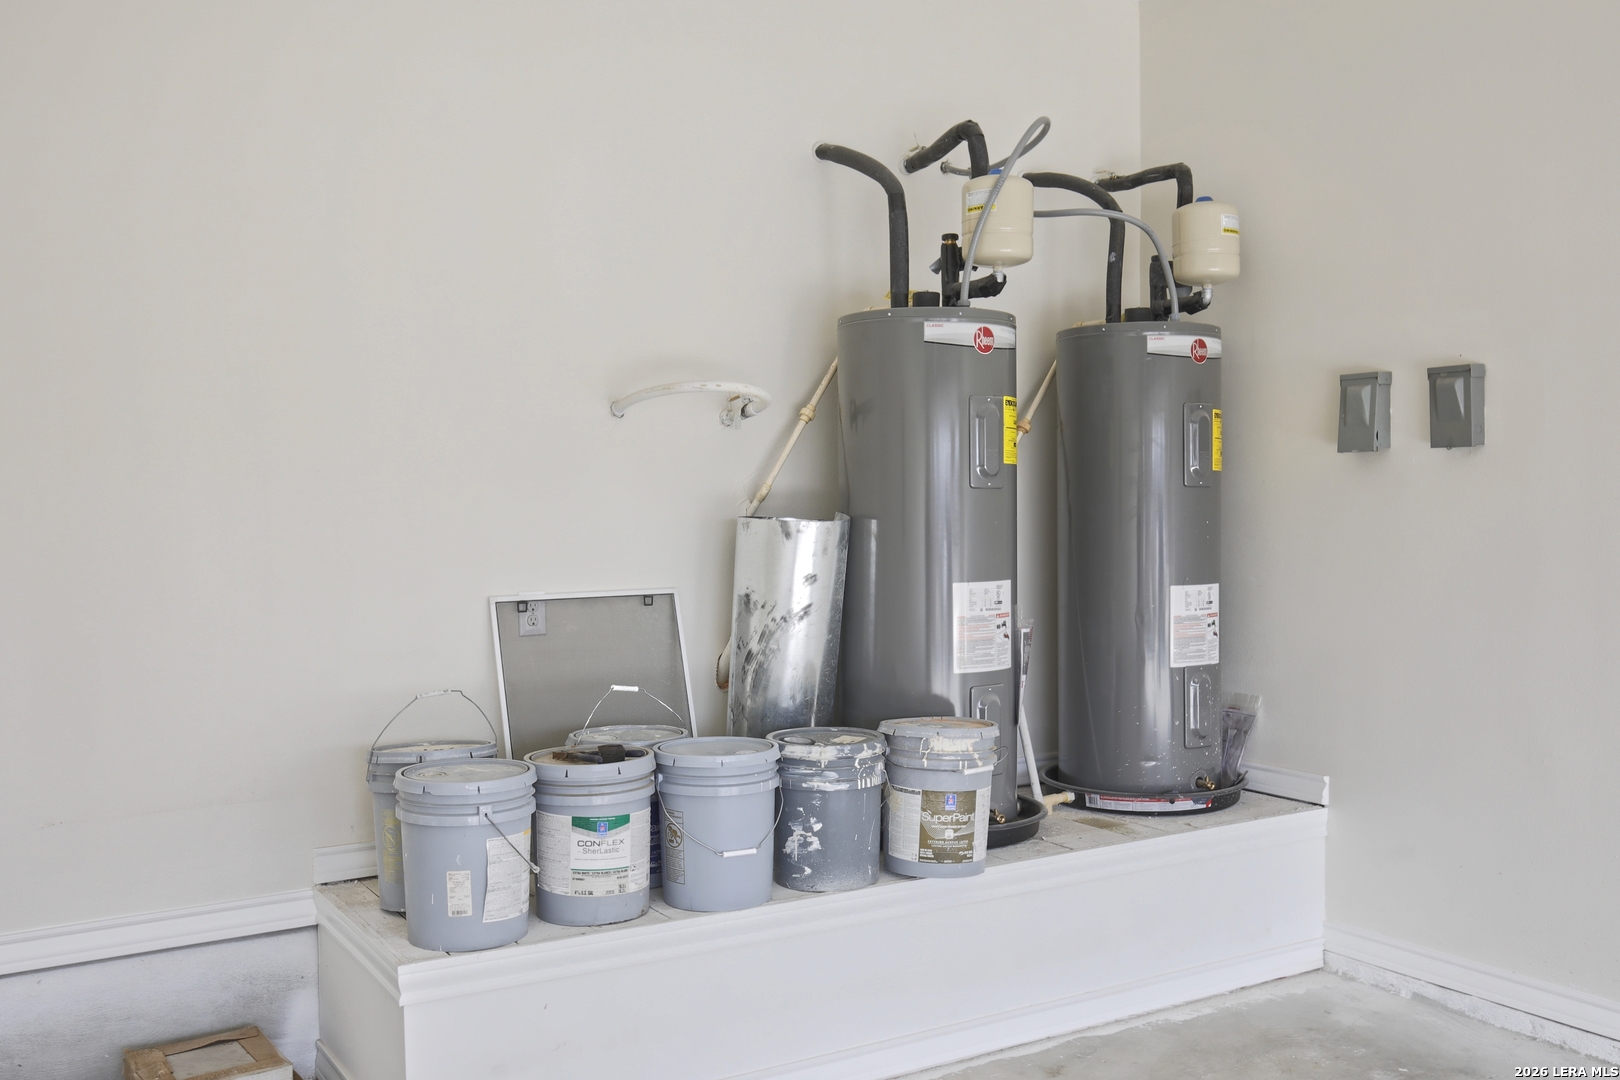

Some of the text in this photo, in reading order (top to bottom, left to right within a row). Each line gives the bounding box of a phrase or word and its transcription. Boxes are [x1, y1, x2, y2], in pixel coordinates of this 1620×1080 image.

[975, 326, 994, 349] Rheem
[921, 811, 975, 824] SuperPaint
[577, 838, 625, 847] CONFLEX
[582, 847, 620, 855] SherLastic
